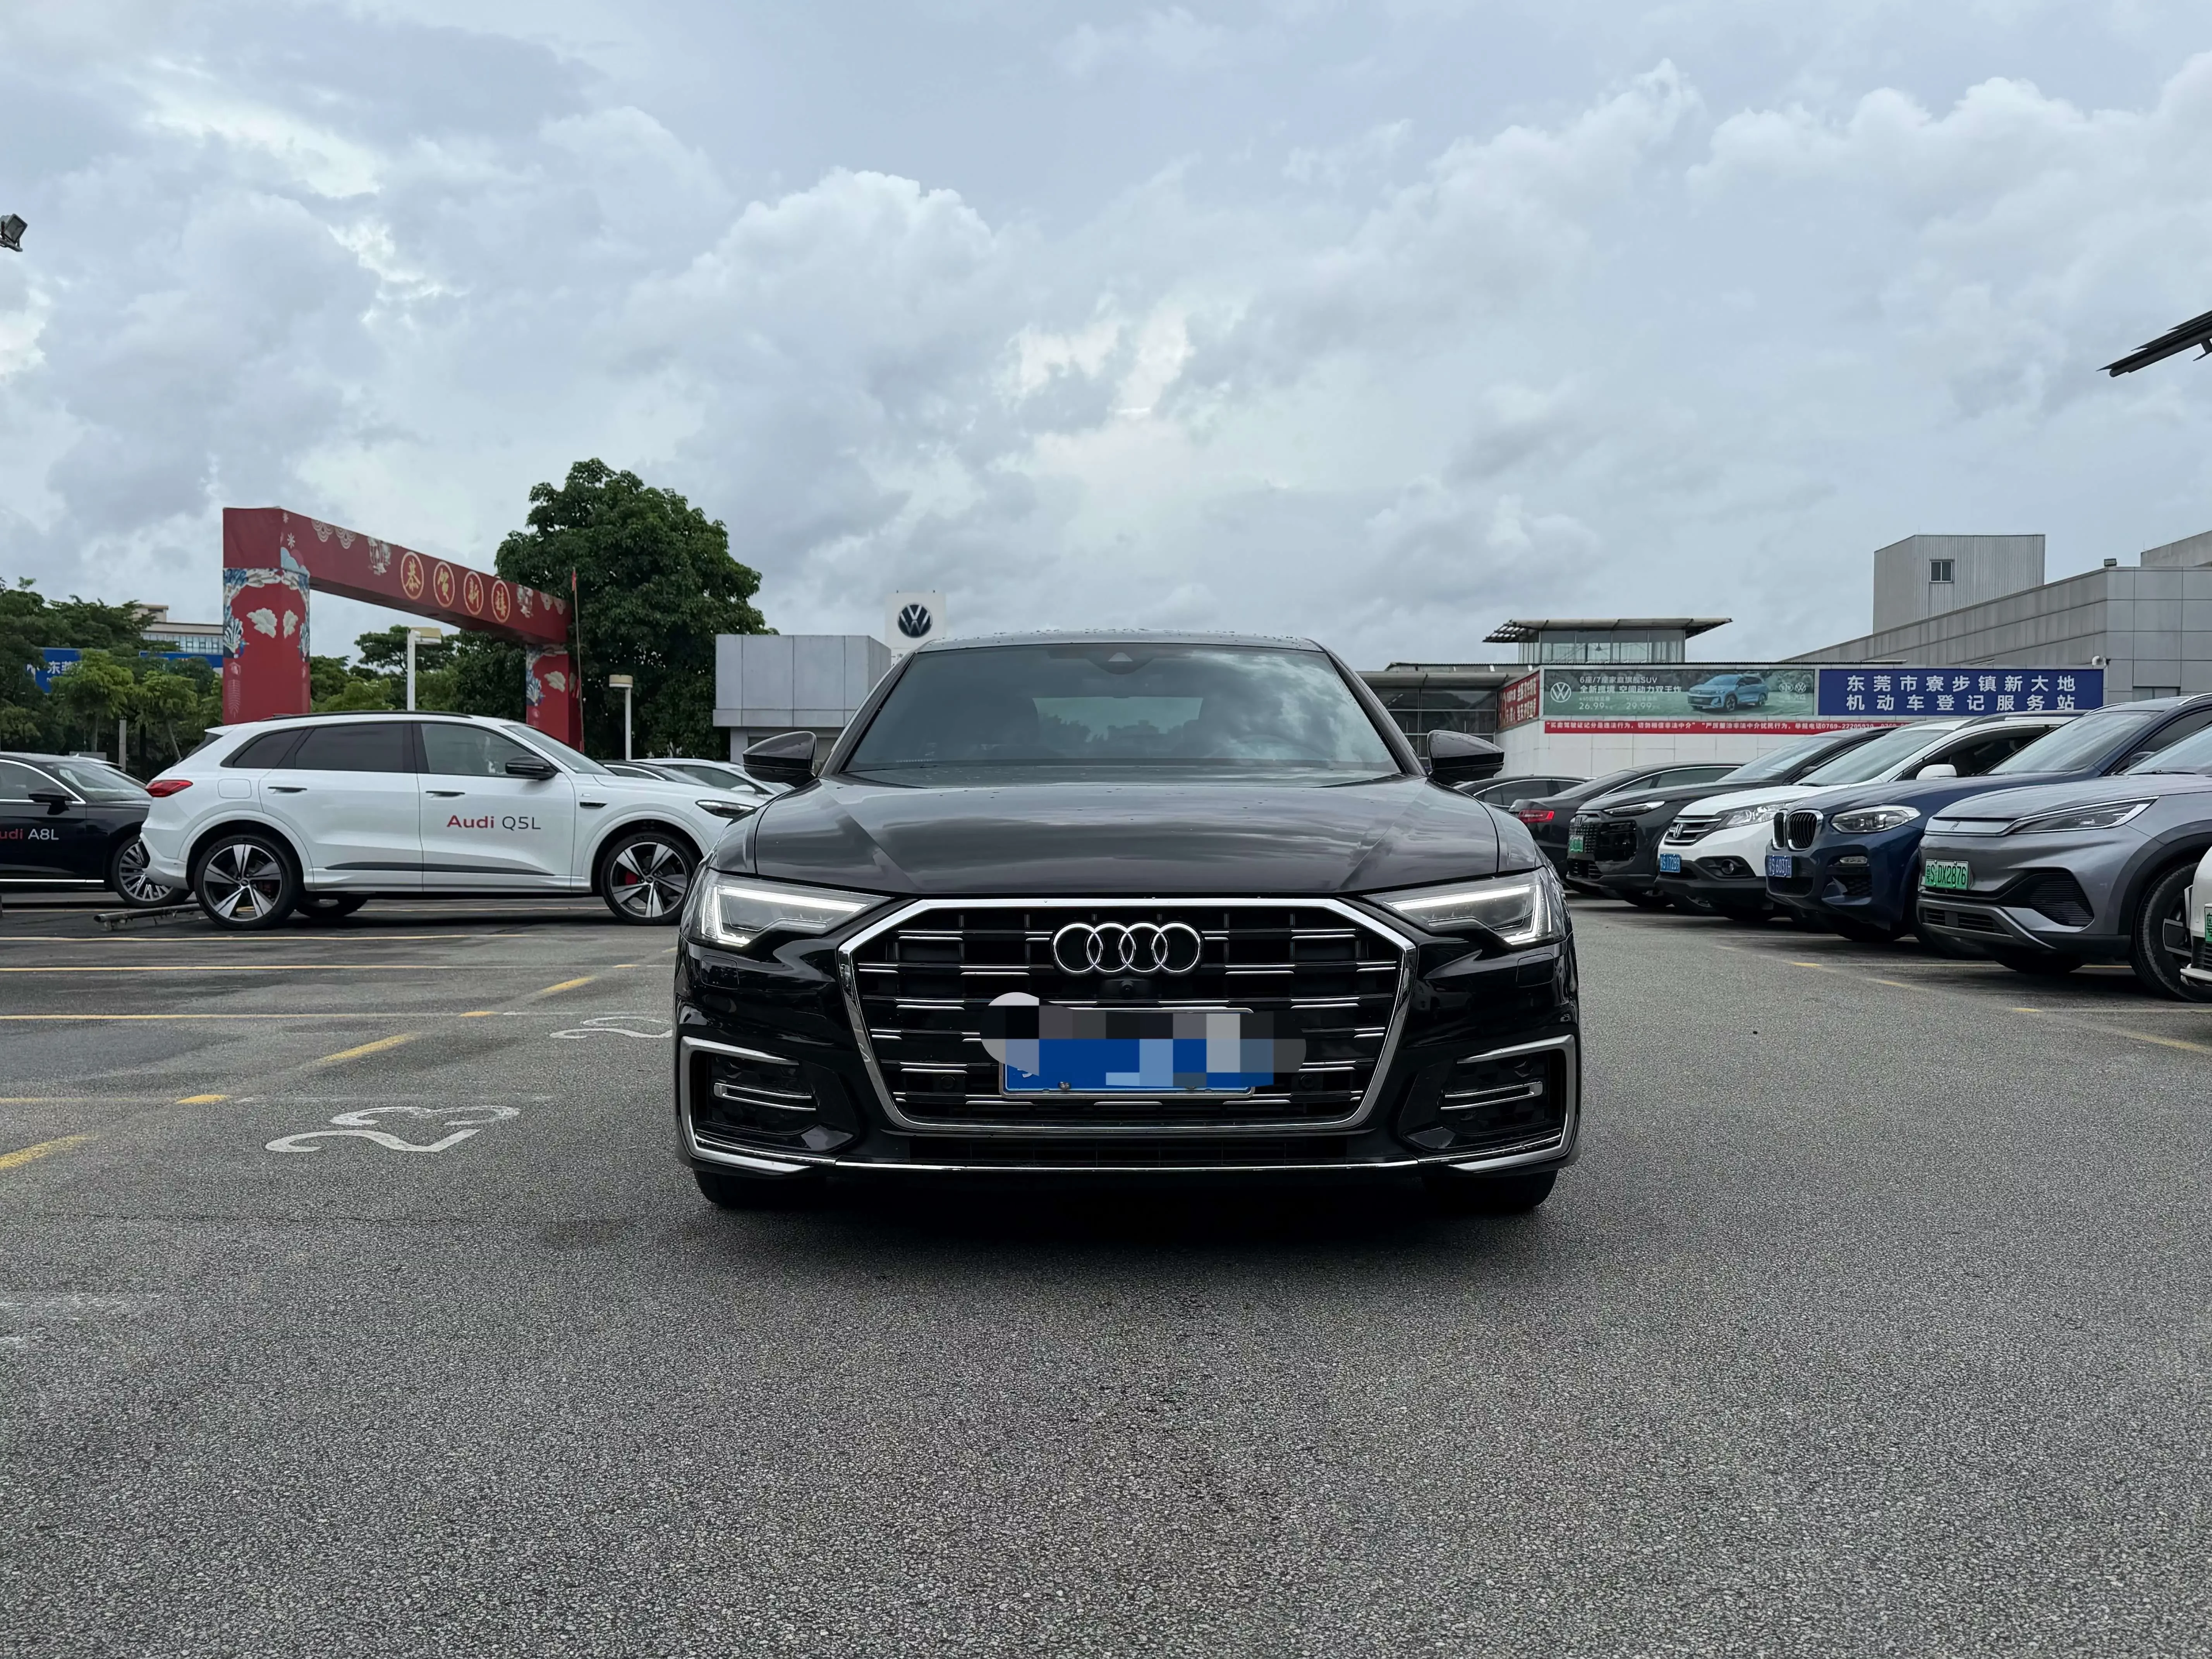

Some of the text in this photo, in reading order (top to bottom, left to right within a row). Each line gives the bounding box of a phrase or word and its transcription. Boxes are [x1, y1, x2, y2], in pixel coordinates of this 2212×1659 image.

[1846, 675, 2076, 692] 东莞市寮步镇新大地
[1846, 694, 2075, 711] 机动车登记服务站
[447, 815, 541, 831] Audi Q5L
[0, 828, 59, 840] udi A8L
